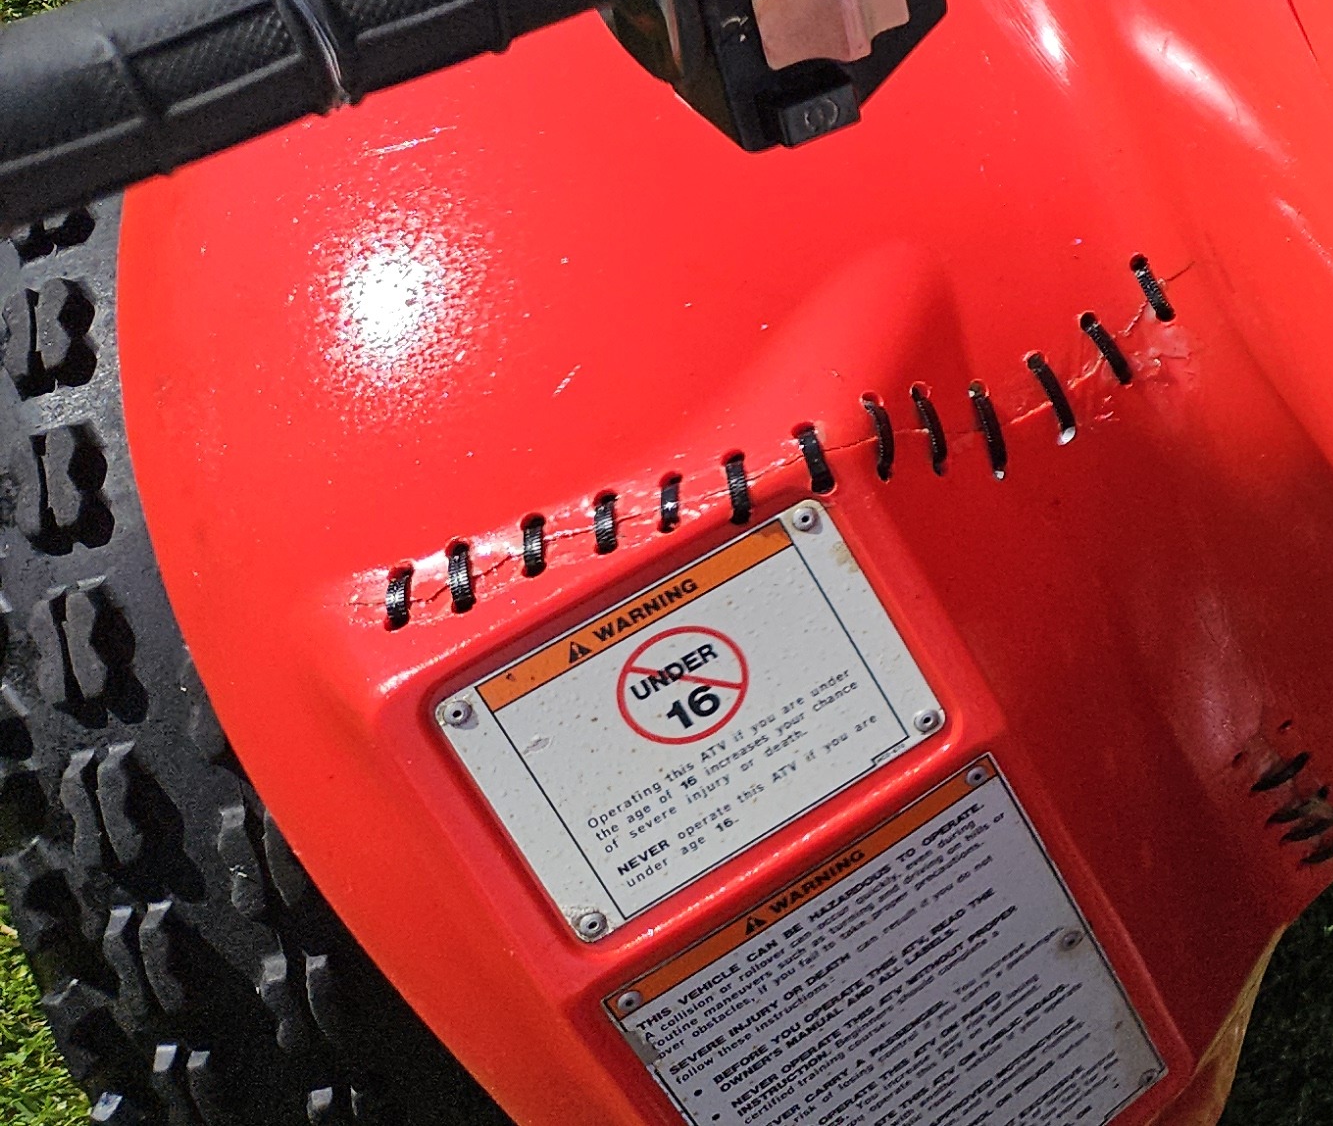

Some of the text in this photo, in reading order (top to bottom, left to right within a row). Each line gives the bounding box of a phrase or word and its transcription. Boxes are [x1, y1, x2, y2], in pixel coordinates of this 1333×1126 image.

[591, 578, 699, 642] WARNING
[629, 643, 719, 701] UNDER
[665, 685, 721, 730] 16
[587, 669, 849, 829] Operating this ATV if you are under
[595, 681, 858, 842] the age of 16 increases your chance
[604, 730, 808, 854] of severe injury or death.
[617, 715, 877, 876] NEVER operate this ATV if you are
[626, 817, 739, 888] under age 16.
[768, 849, 866, 914] WARNING
[635, 802, 985, 1031] THIS VEHICLE CAN BE HAZARDOUS TO OPERATE.
[644, 1031, 656, 1047] A
[660, 995, 715, 1032] collision
[719, 982, 732, 994] or
[738, 947, 785, 982] rollover
[788, 930, 813, 949] can
[937, 820, 977, 850] during
[703, 970, 773, 1018] maneuvers
[776, 947, 807, 970] such
[811, 935, 827, 948] as
[827, 900, 876, 935] turning
[877, 883, 901, 904] and
[902, 854, 945, 886] driving
[963, 823, 991, 842] hills
[992, 812, 1005, 824] or
[654, 1038, 685, 1060] over
[691, 997, 756, 1038] obstacles,
[757, 984, 768, 996] if
[772, 967, 796, 987] you
[821, 940, 837, 953] to
[668, 1034, 727, 1076] SEVERE
[728, 999, 779, 1038] INJURY
[782, 984, 804, 1001] OR
[804, 952, 852, 987] DEATH
[712, 1043, 769, 1085] BEFORE
[770, 1021, 802, 1045] YOU
[803, 977, 866, 1024] OPERATE
[865, 955, 898, 980] THIS
[929, 908, 967, 937] READ
[966, 887, 996, 909] THE
[719, 1047, 784, 1093] OWNER'S
[785, 1007, 845, 1049] MANUAL
[847, 984, 876, 1008] AND
[877, 966, 904, 986] ALL
[730, 1073, 780, 1109] NEVER
[780, 1028, 842, 1074] OPERATE
[842, 1005, 876, 1029] THIS
[878, 984, 903, 1008] ATV
[905, 940, 964, 987] WITHOUT
[675, 1056, 714, 1085] follow
[717, 1032, 752, 1058] these
[736, 1050, 833, 1118] INSTRUCTION.
[834, 1004, 895, 1050] Beginners
[744, 1085, 796, 1125] certified
[797, 1051, 846, 1087] training
[793, 1105, 817, 1123] risk
[821, 1090, 834, 1104] of
[837, 1063, 875, 1091] losing
[804, 1067, 849, 1104] CARRY
[855, 1058, 866, 1069] A
[817, 1080, 879, 1125] OPERATE
[878, 1057, 911, 1081] THIS
